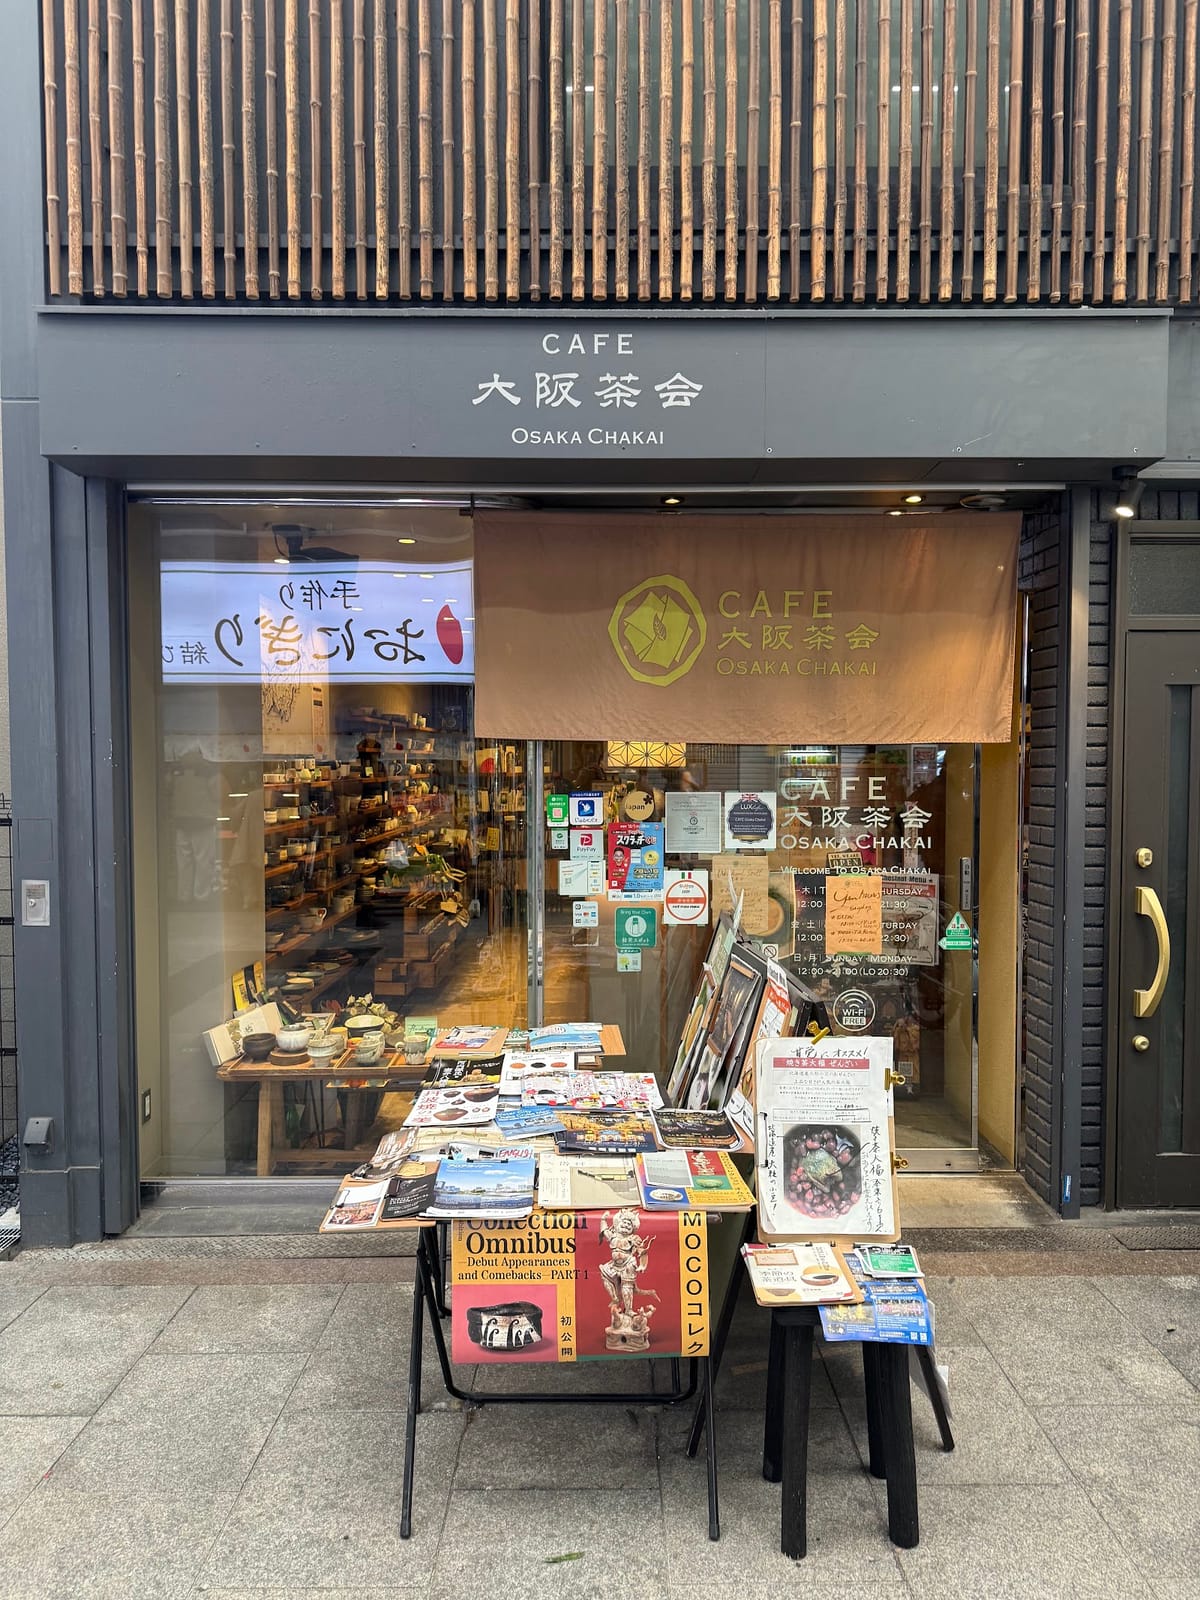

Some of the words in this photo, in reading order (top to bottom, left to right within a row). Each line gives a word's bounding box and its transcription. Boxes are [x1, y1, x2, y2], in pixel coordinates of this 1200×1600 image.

[541, 333, 634, 355] CAFE
[471, 372, 704, 409] 大阪茶会
[718, 590, 834, 619] CAFE
[717, 622, 881, 650] 大阪茶会
[780, 776, 888, 801] CAFE
[780, 806, 933, 829] 大阪茶会
[832, 858, 860, 867] OPEN
[881, 888, 923, 896] HURSDAY
[796, 934, 823, 942] 12:00
[841, 1008, 867, 1017] WI-FI
[466, 1231, 577, 1255] Omnibus
[501, 1256, 571, 1269] Appearances
[458, 1269, 479, 1280] and
[560, 1315, 573, 1357] 初公開
